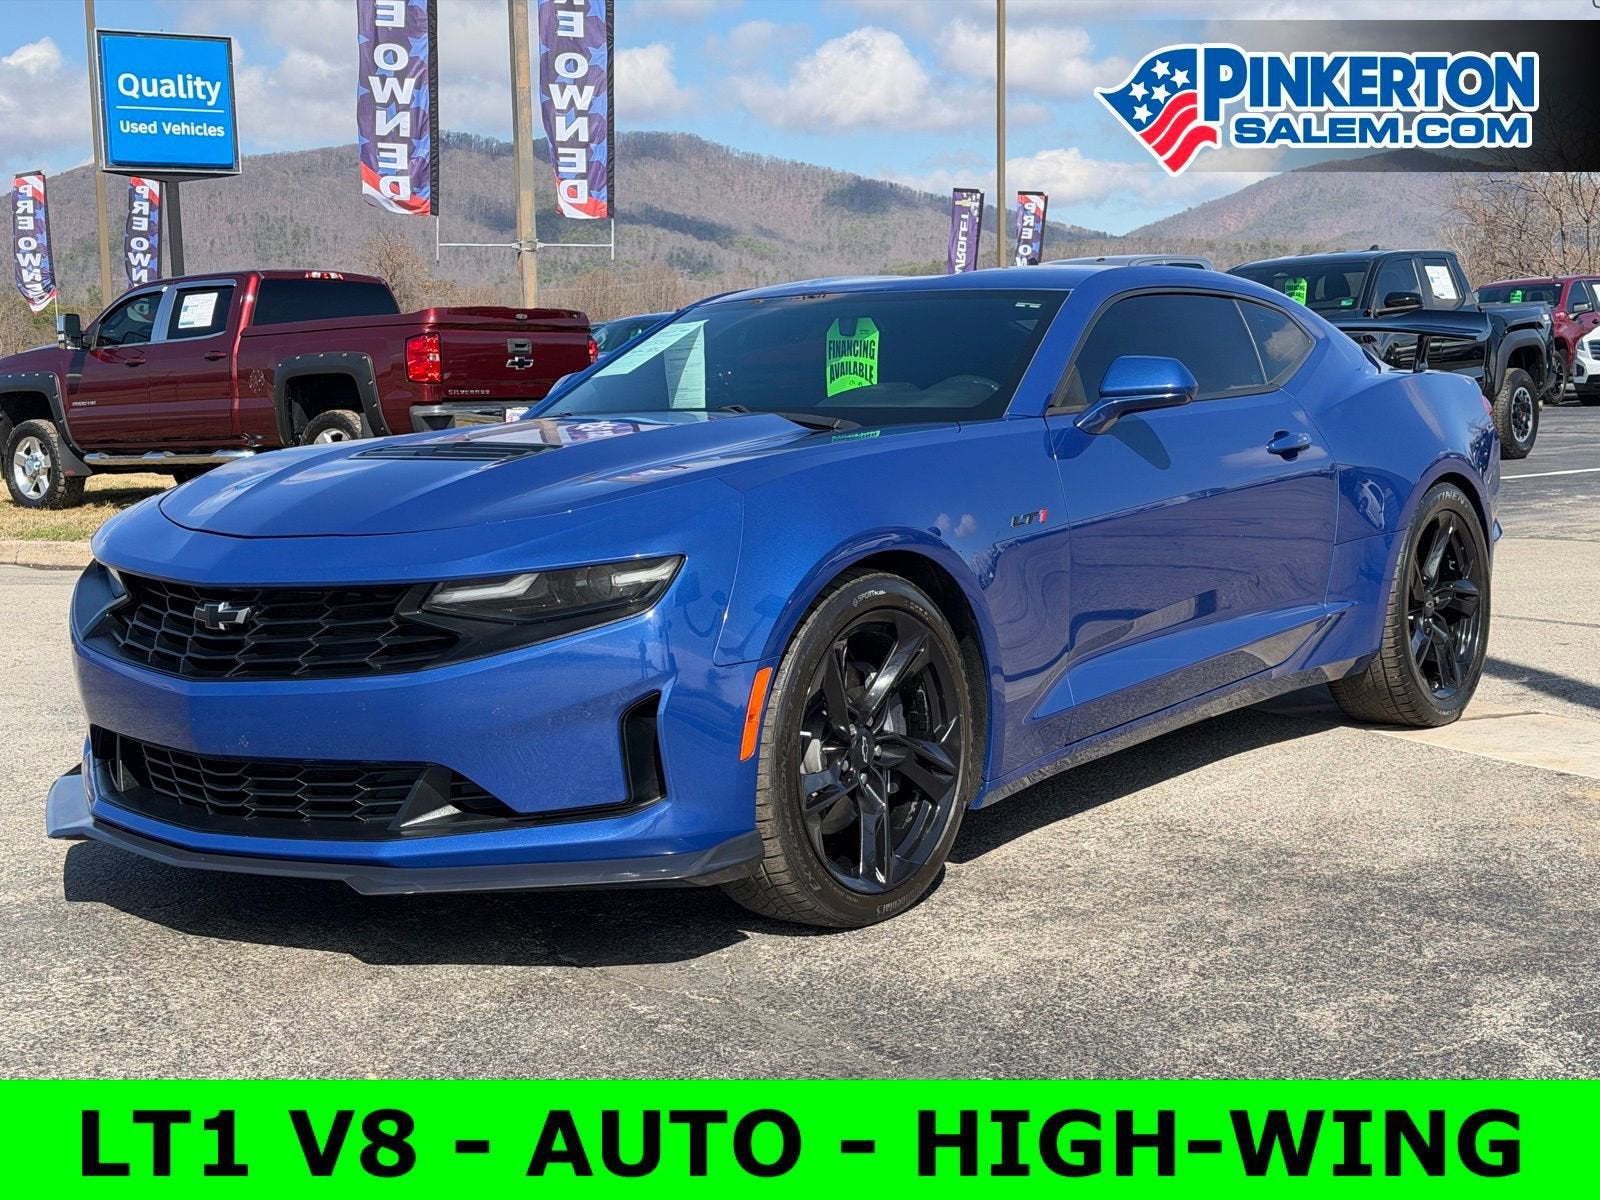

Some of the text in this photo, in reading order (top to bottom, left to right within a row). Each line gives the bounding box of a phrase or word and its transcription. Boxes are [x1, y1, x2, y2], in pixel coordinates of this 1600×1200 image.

[117, 72, 221, 107] Quality
[119, 119, 226, 138] Used Vehicles
[828, 339, 876, 360] FINANCING
[829, 360, 874, 386] AVAILABLE
